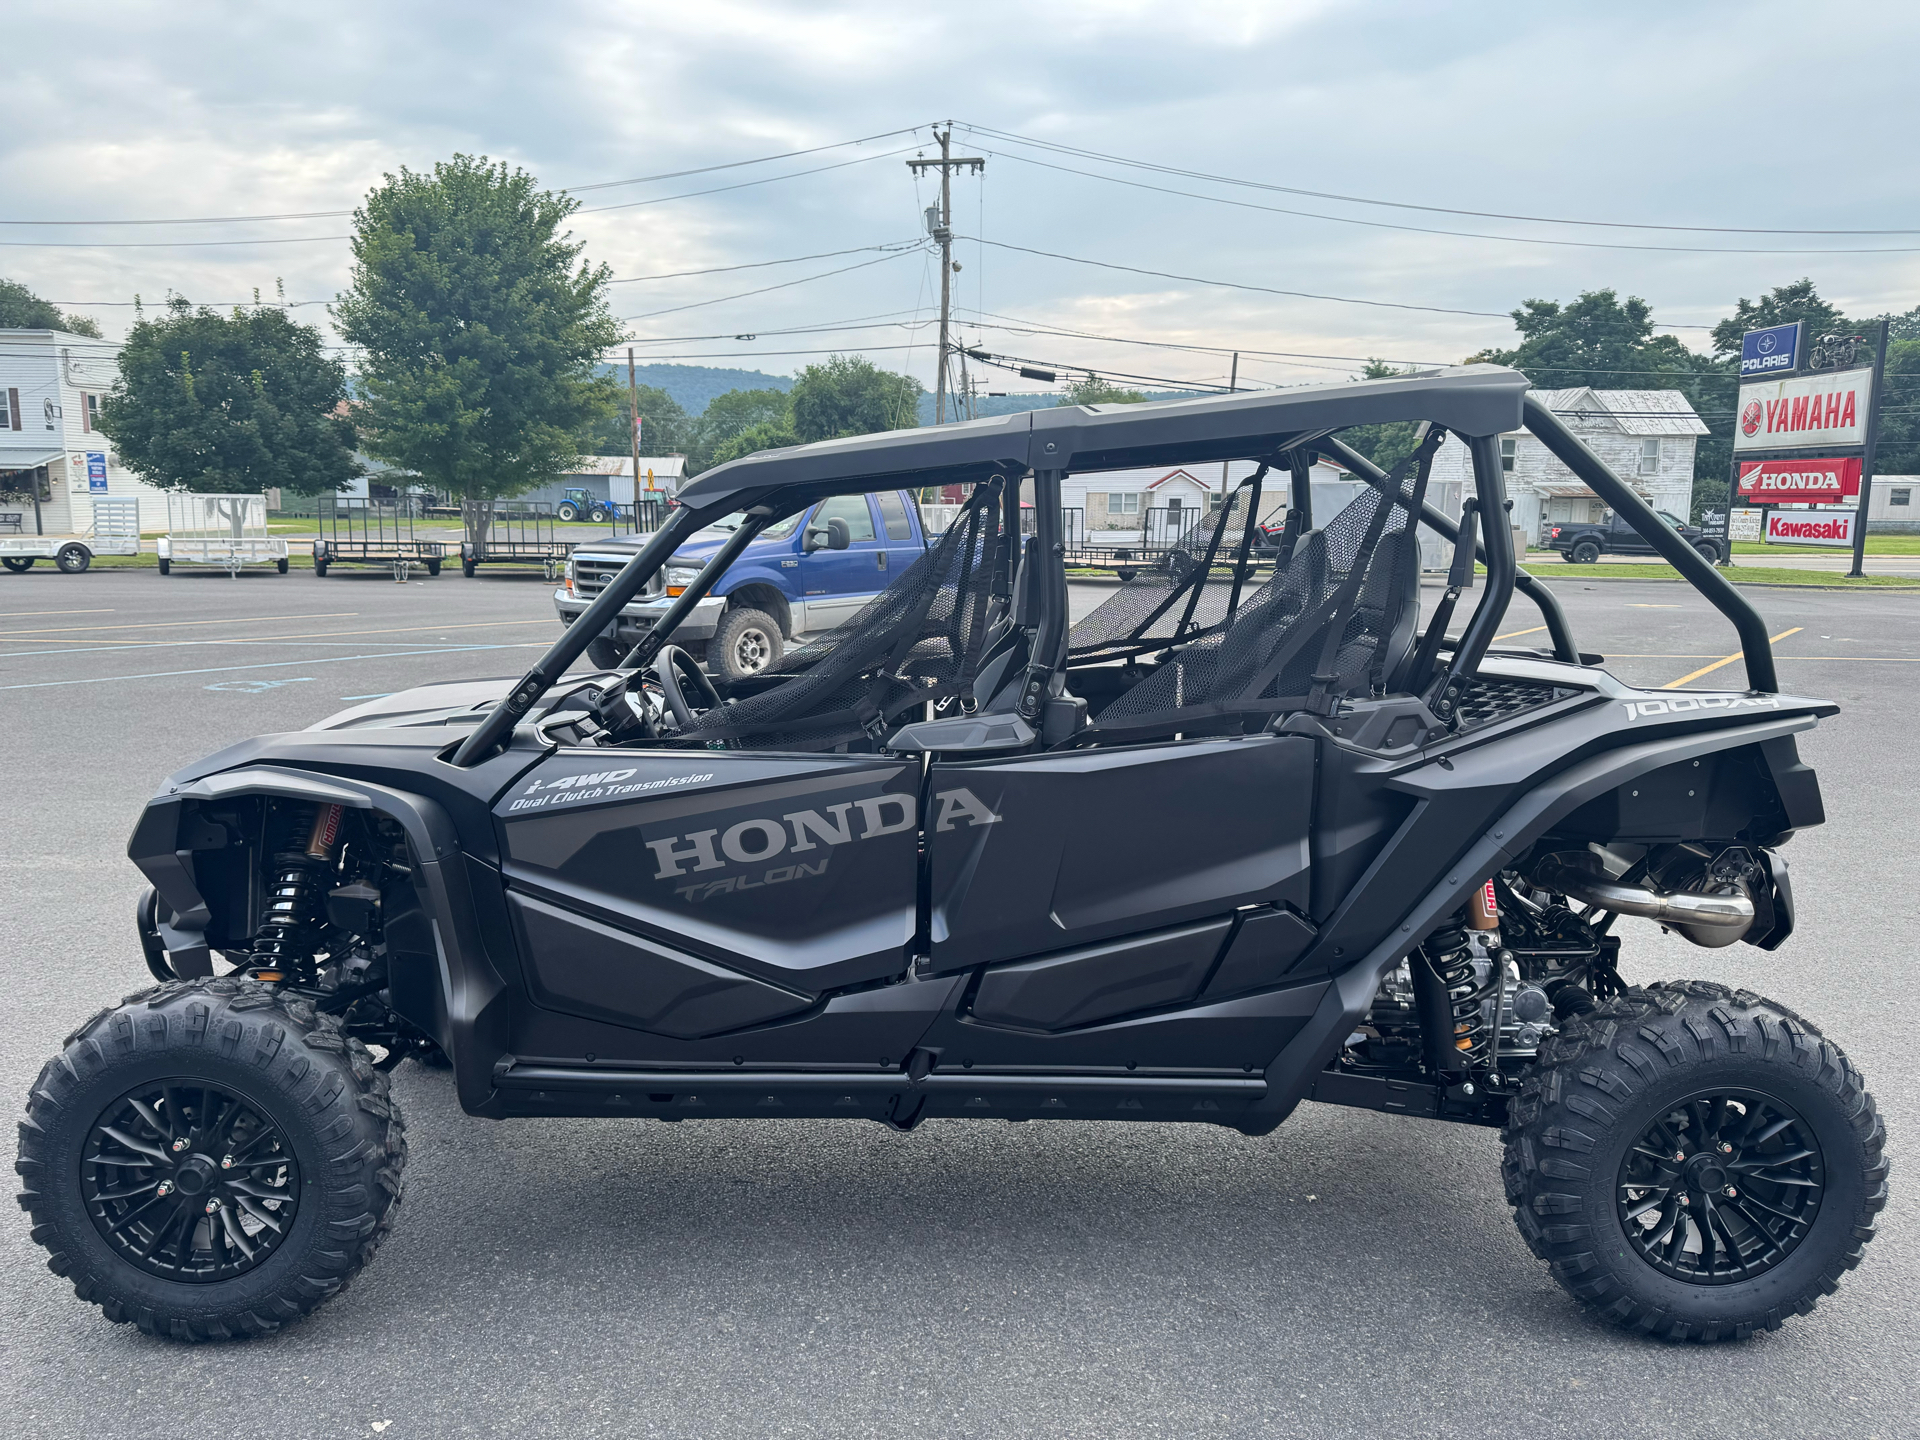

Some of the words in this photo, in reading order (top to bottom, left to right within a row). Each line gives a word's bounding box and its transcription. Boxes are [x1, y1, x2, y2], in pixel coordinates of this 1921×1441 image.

[1741, 353, 1789, 371] POLARIS
[1766, 390, 1856, 434] YAMAHA
[1760, 472, 1841, 490] HONDA
[1769, 517, 1849, 539] Kawasaki
[509, 795, 550, 811] Dual
[550, 789, 602, 804] Clutch
[605, 773, 714, 796] Transmission
[524, 768, 638, 795] i-4WD
[645, 787, 1003, 880] HONDA
[674, 859, 829, 903] TALON
[1595, 1176, 1644, 1283] KENDA
[184, 1248, 294, 1308] KENDA
